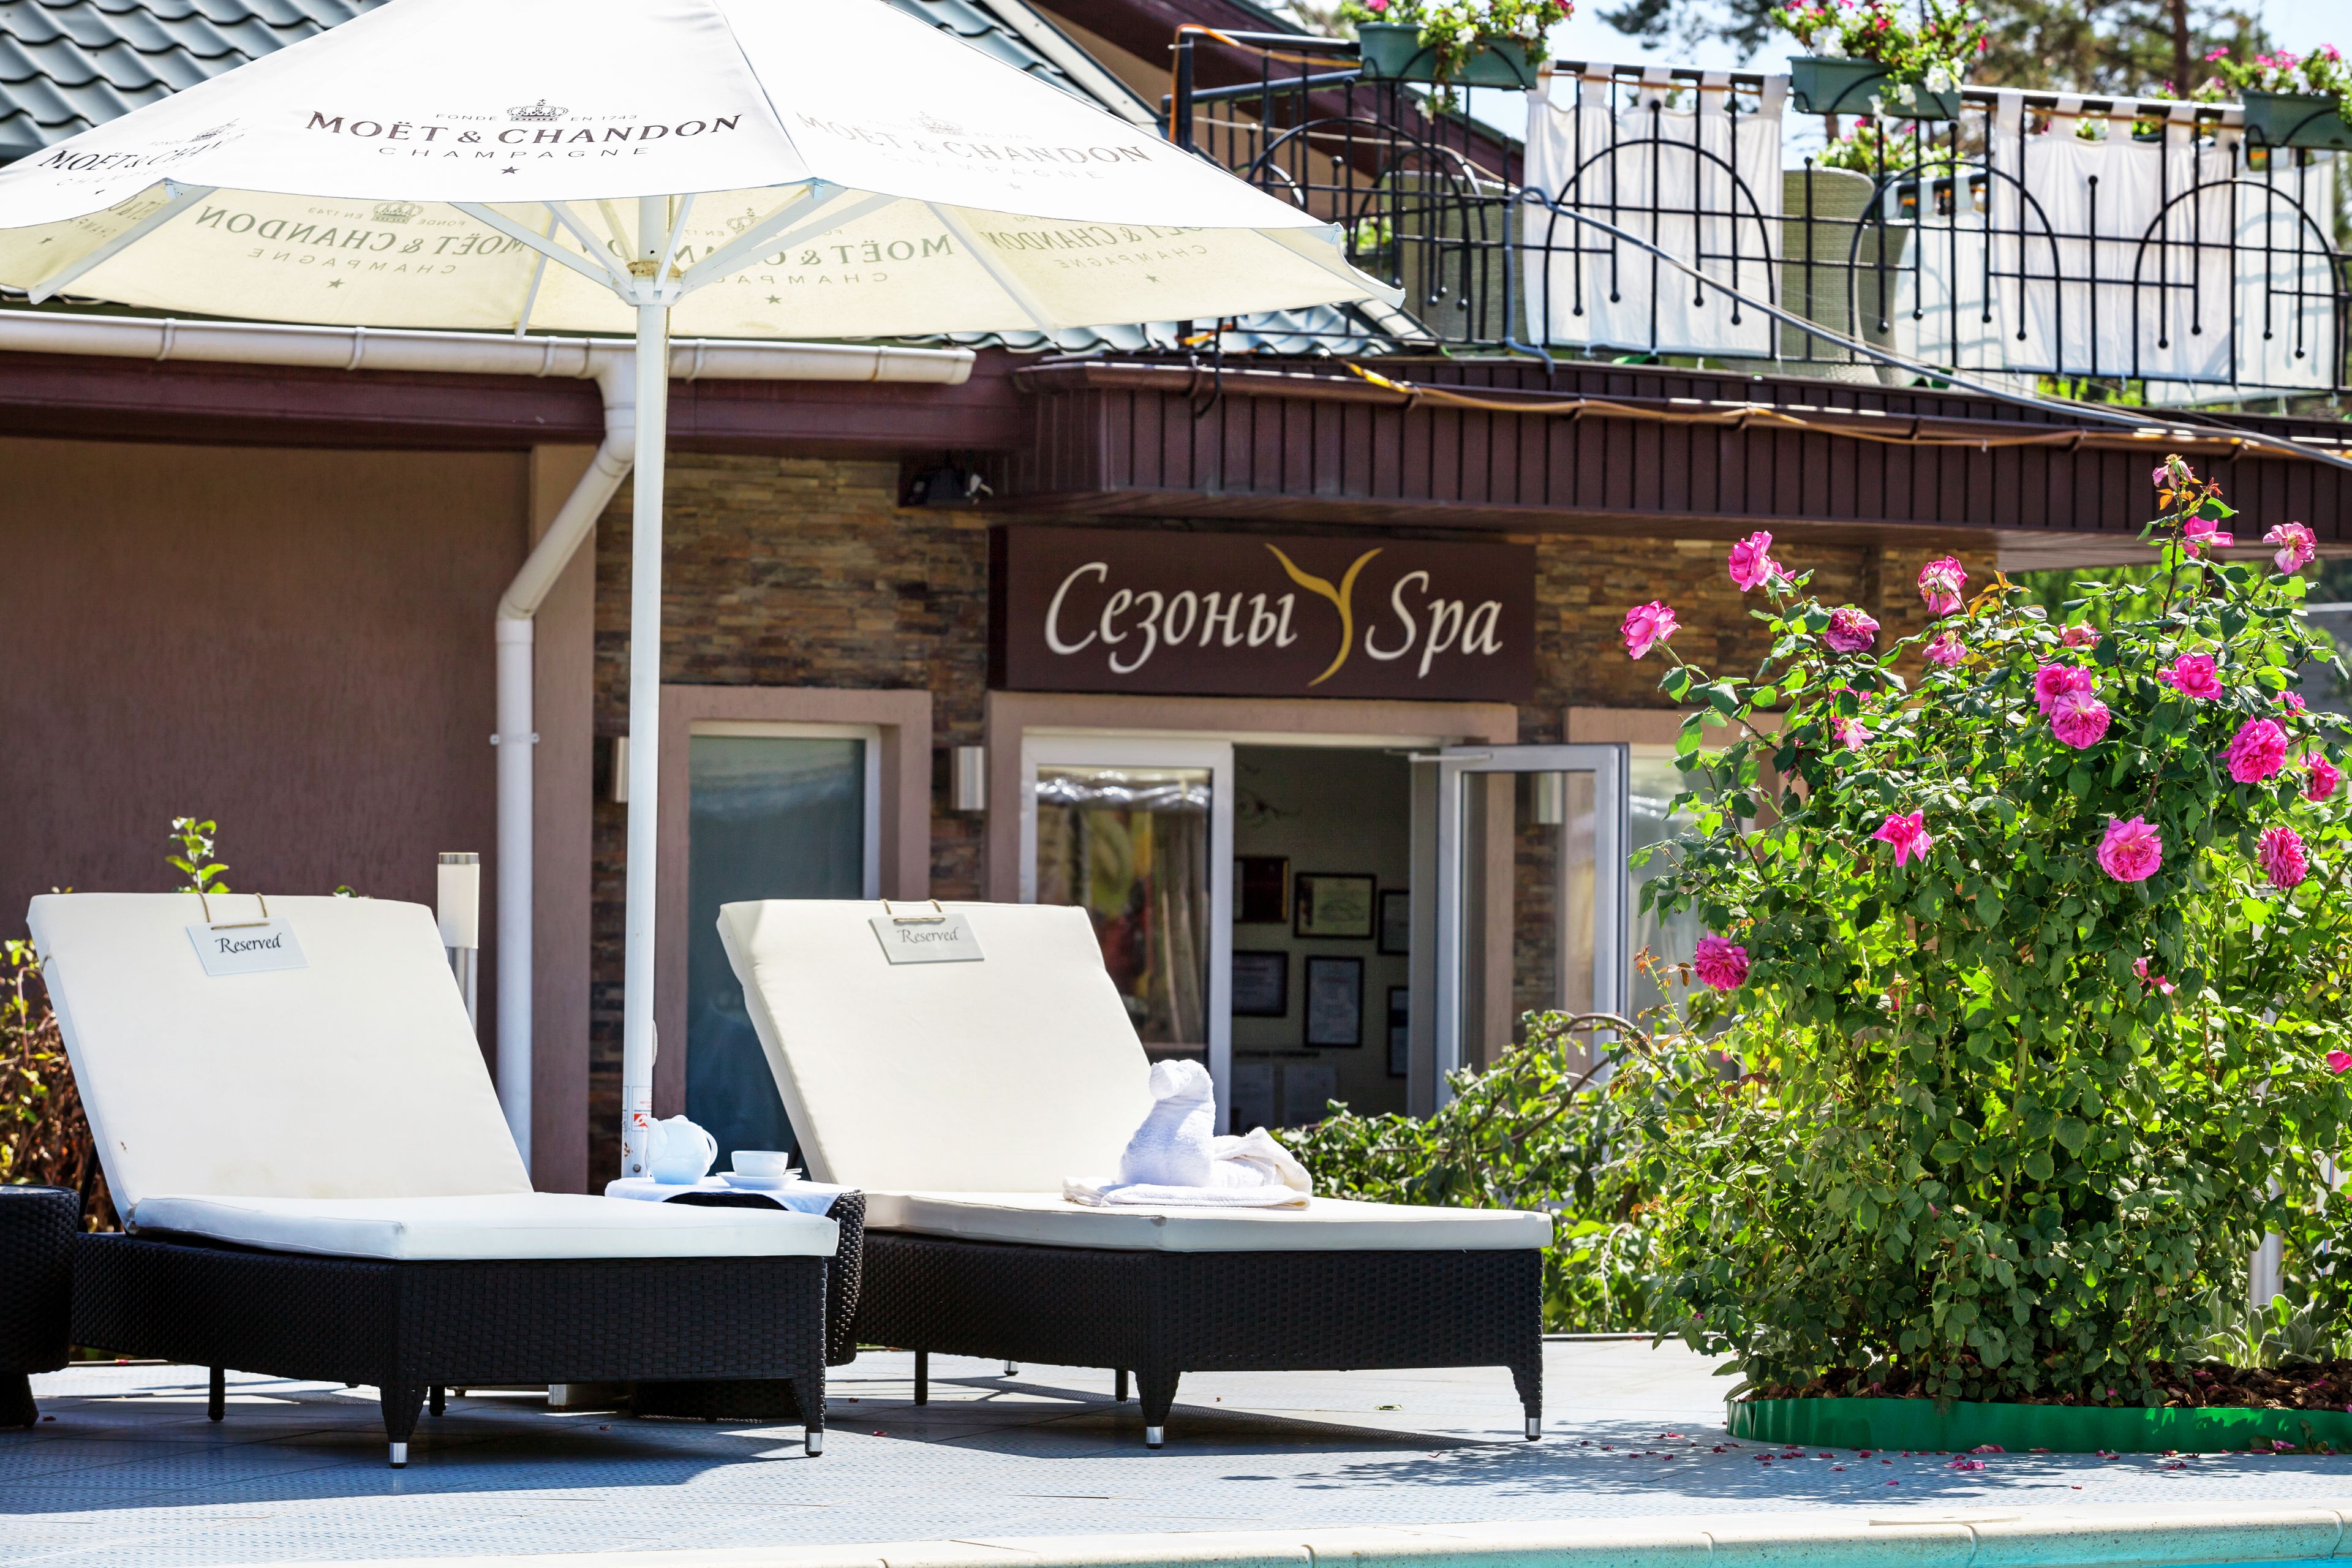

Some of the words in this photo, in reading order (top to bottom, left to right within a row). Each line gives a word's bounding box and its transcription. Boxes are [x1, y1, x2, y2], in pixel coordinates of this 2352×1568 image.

[305, 111, 448, 141] MOËT
[458, 130, 483, 143] &
[498, 114, 743, 144] CHANDON
[38, 150, 138, 170] MOËT
[379, 147, 649, 159] CHAMPAGNE
[913, 140, 941, 154] &
[943, 141, 1153, 163] CHANDON
[882, 153, 1104, 179] CHAMPAGNE
[1045, 562, 1297, 674] Сезоны
[1365, 570, 1503, 679] Spa
[214, 932, 282, 954] Reserved
[897, 927, 959, 944] Reserved
